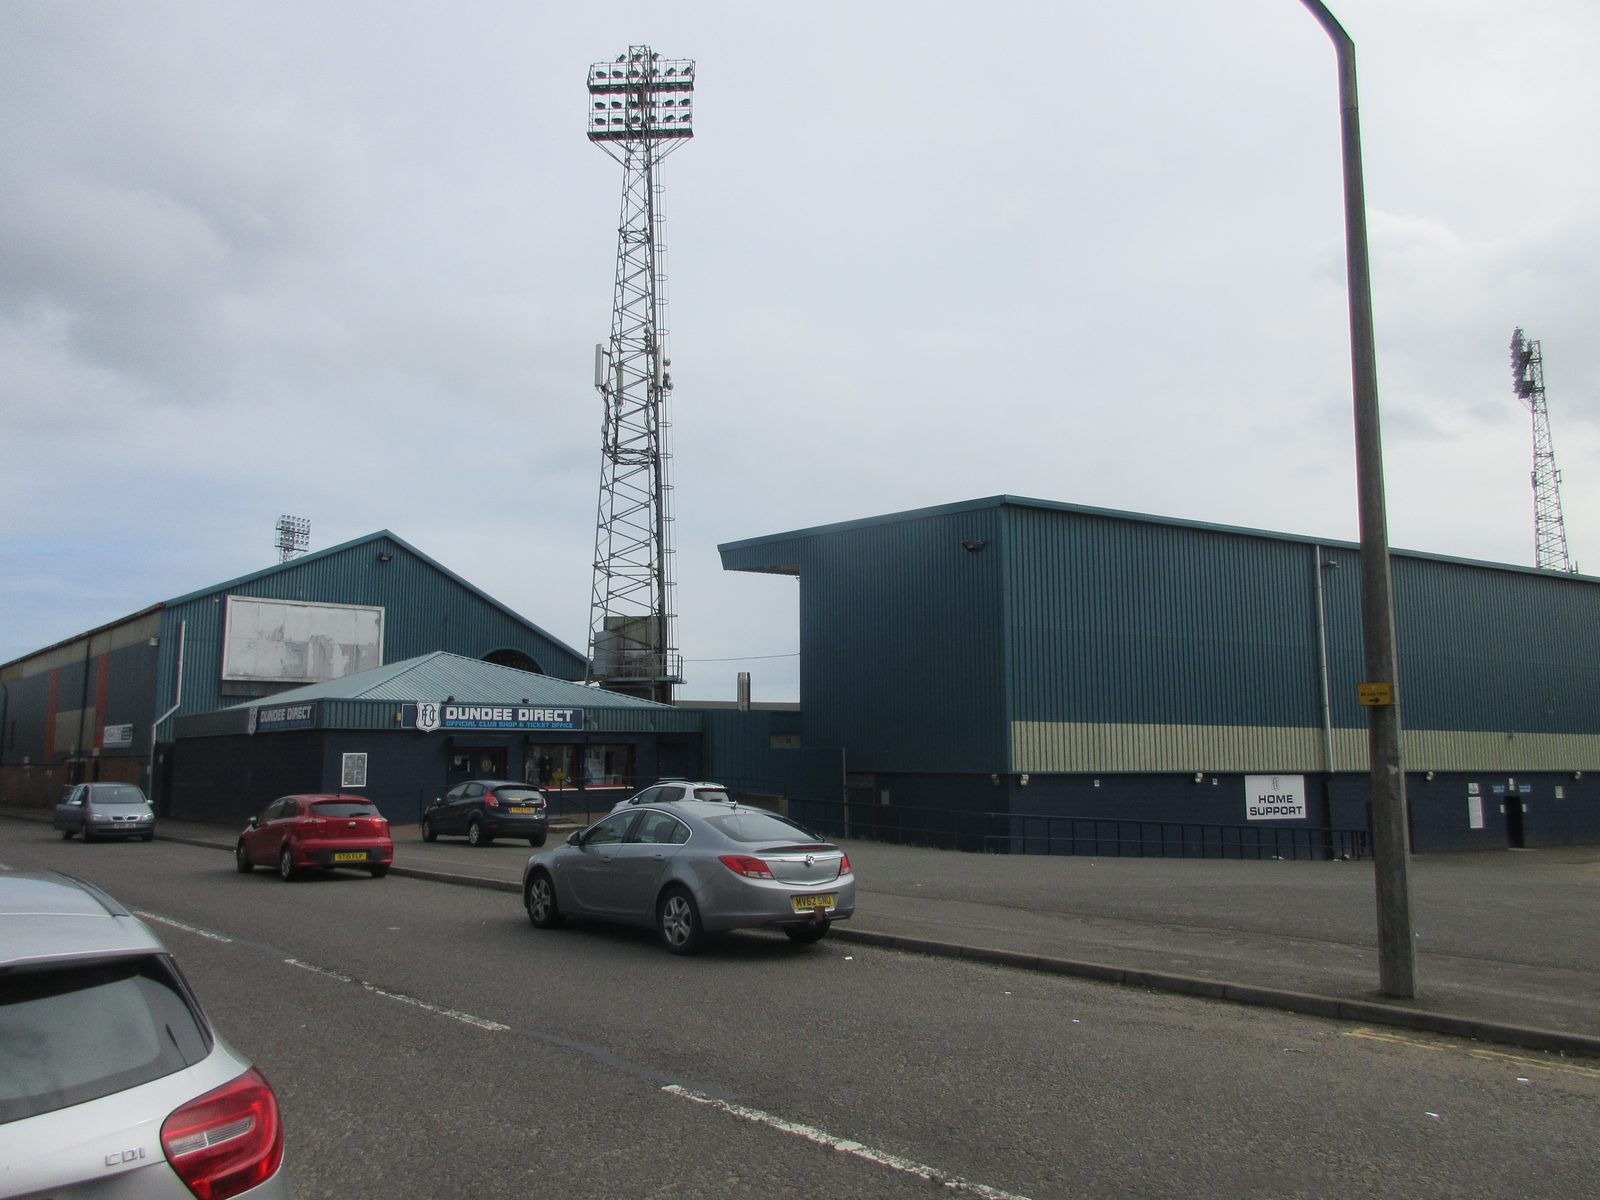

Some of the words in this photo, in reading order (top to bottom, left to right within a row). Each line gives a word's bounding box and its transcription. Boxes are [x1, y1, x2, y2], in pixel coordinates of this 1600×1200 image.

[260, 709, 285, 723] DUNDEE
[287, 706, 312, 720] DIRECT
[446, 707, 513, 721] DUNDEE
[518, 708, 574, 722] DIRECT
[1258, 794, 1293, 804] HOME
[1250, 806, 1303, 816] SUPPORT
[105, 1146, 146, 1166] CDI
